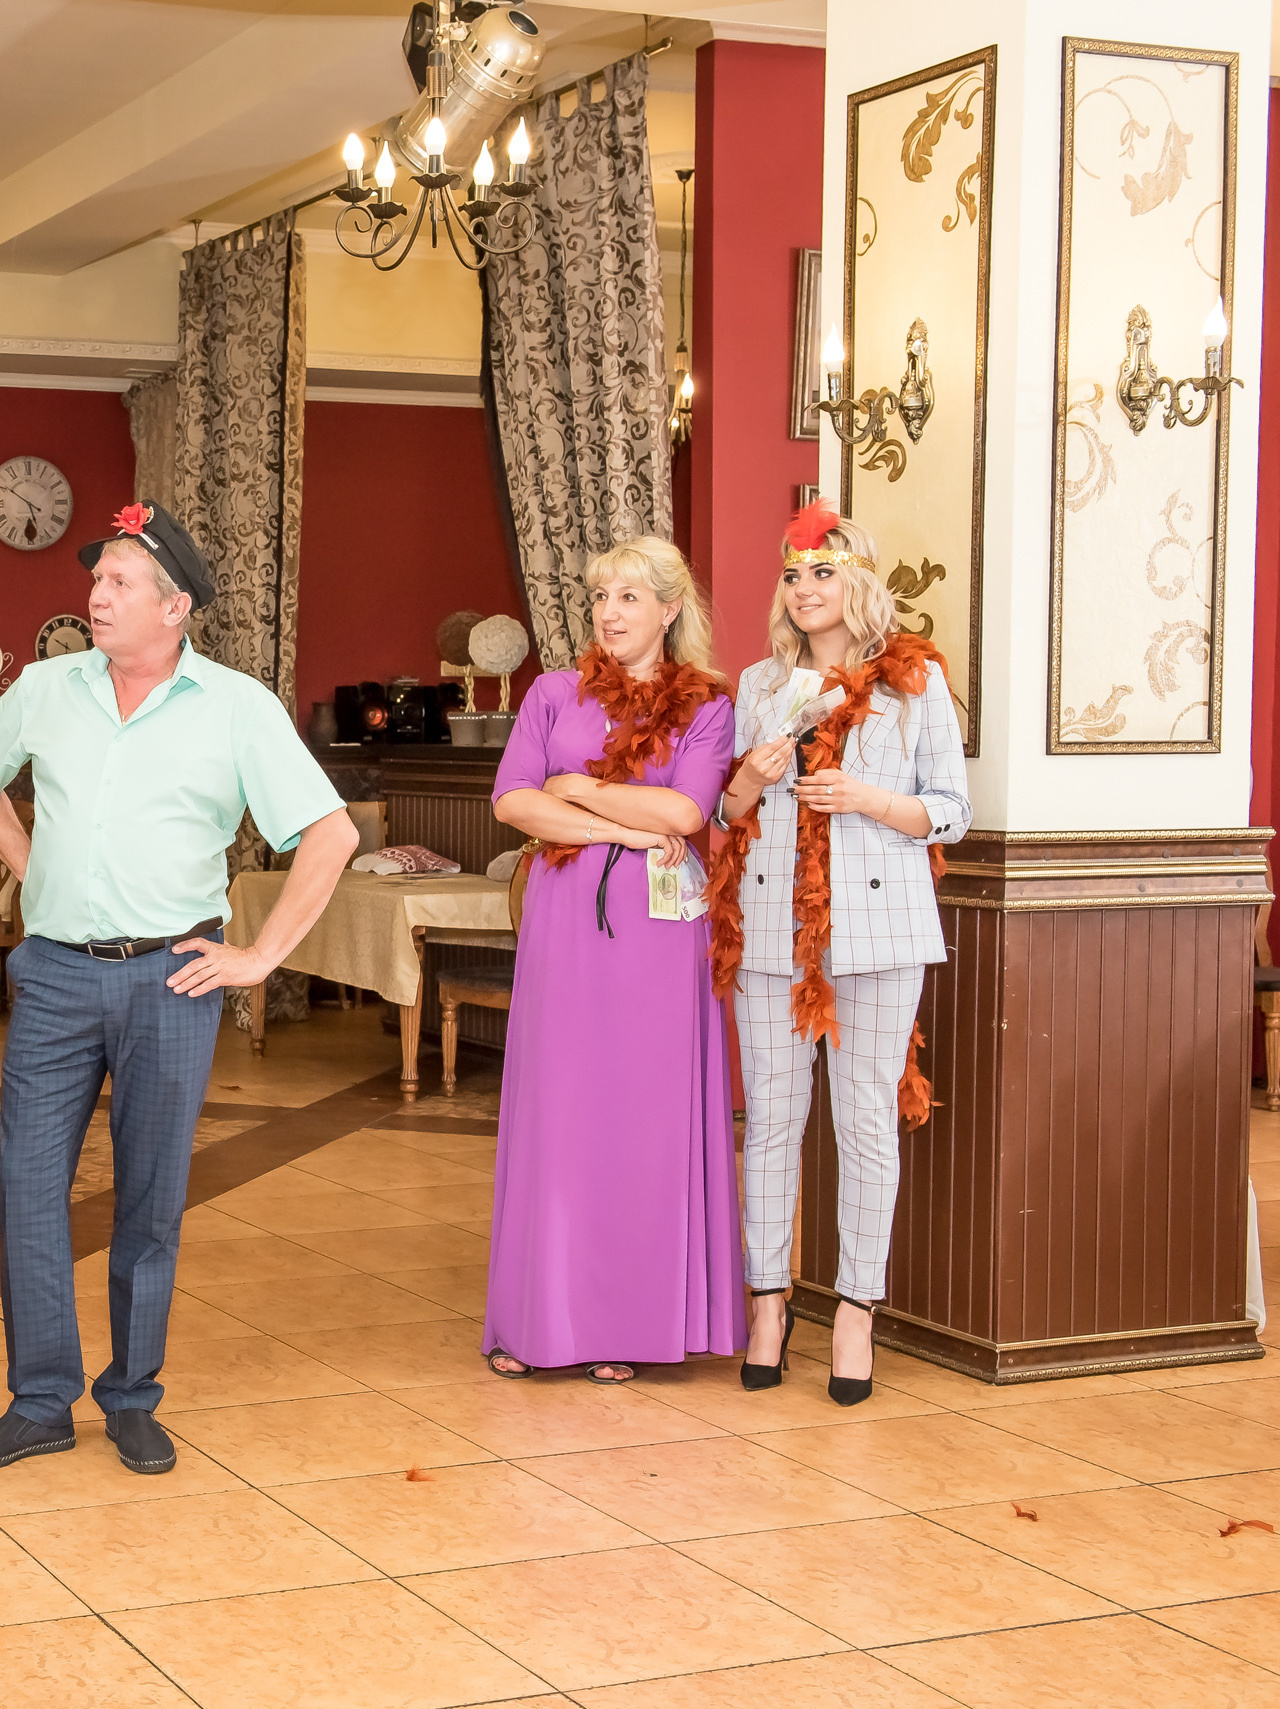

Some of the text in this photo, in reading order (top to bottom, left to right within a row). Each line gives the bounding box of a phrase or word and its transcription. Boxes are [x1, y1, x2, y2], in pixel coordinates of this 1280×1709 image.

[52, 620, 60, 630] 11
[64, 618, 72, 627] 12
[76, 622, 82, 630] 1
[682, 905, 691, 919] 500
